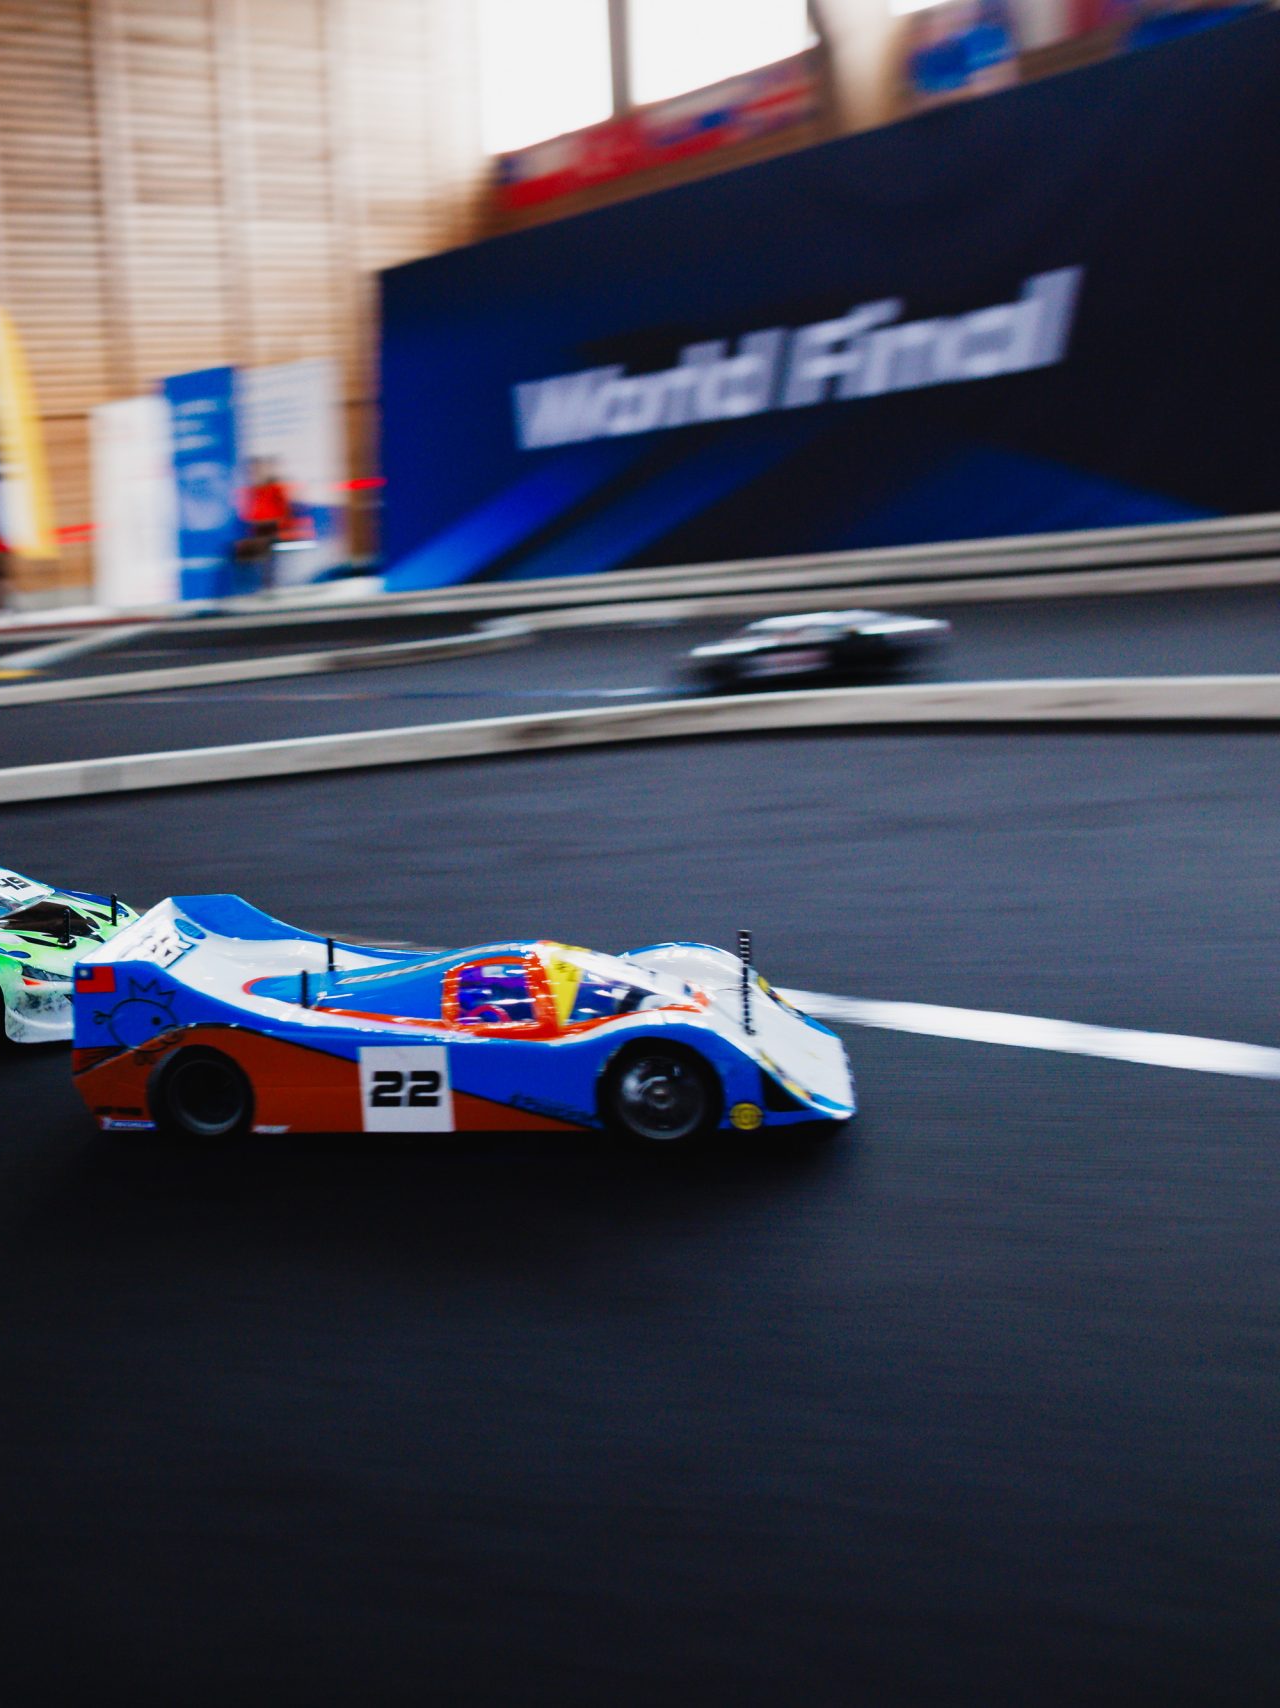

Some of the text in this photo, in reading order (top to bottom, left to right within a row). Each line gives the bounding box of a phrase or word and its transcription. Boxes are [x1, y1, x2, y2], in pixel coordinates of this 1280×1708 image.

[516, 264, 1082, 449] World Final
[370, 1070, 441, 1107] 22
